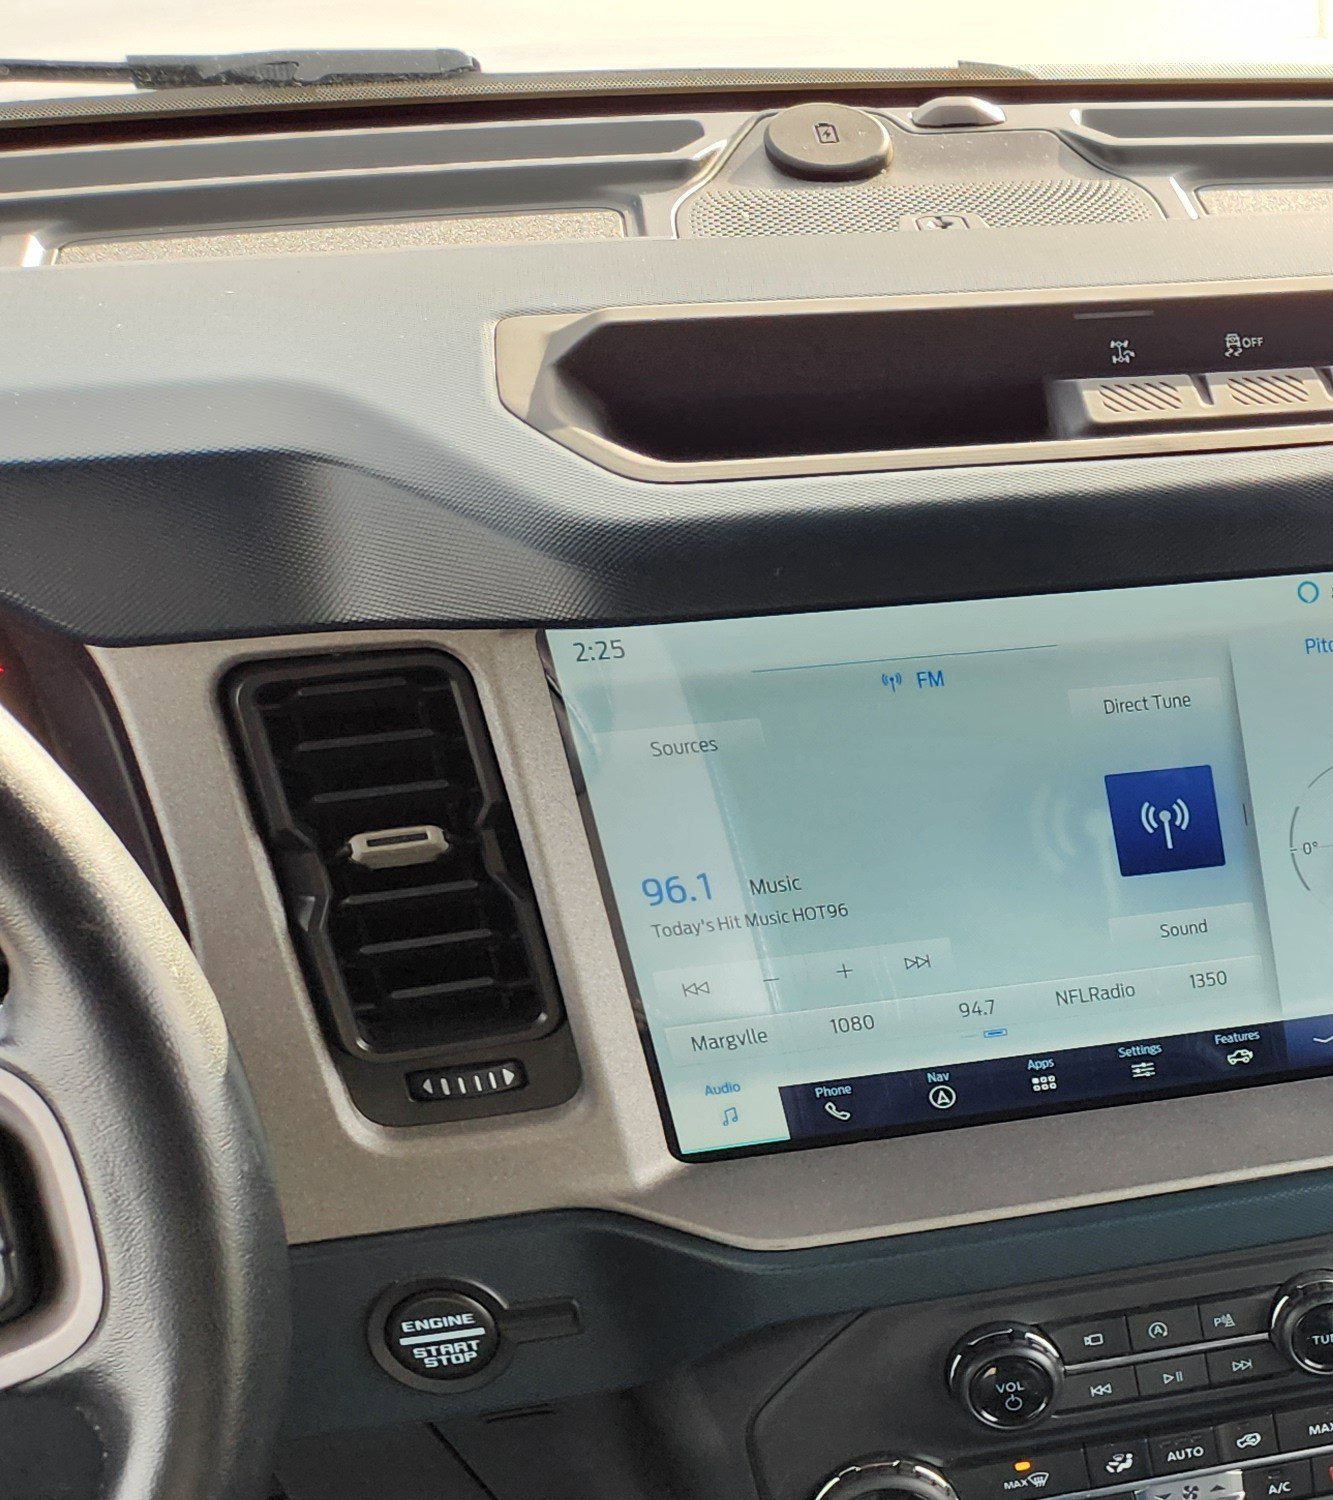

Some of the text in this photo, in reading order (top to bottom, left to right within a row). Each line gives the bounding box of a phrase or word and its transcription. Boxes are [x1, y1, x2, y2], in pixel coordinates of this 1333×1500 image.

[1242, 335, 1264, 349] OFF
[572, 639, 626, 663] 2:25
[916, 670, 945, 689] FM
[1103, 693, 1191, 715] Direct Tune
[650, 736, 719, 758] Sources
[641, 873, 713, 907] 96.1
[749, 875, 802, 896] Music
[651, 902, 850, 940] Today's Hit Music HOT96
[1160, 918, 1208, 939] Sound
[1189, 970, 1228, 989] 1350
[1055, 982, 1136, 1007] NFLRadio
[958, 1000, 996, 1018] 94.7
[829, 1014, 876, 1035] 1080
[690, 1027, 769, 1054] Margvlle
[1214, 1029, 1260, 1046] Features
[1118, 1042, 1163, 1059] Settings
[1027, 1056, 1055, 1072] Apps
[927, 1070, 950, 1084] Nav
[705, 1080, 741, 1097] Audio
[815, 1083, 853, 1099] Phone
[401, 1313, 476, 1334] ENGINE
[412, 1339, 480, 1360] START
[423, 1350, 478, 1369] STOP
[996, 1382, 1025, 1394] VOL
[1167, 1445, 1204, 1462] AUTO
[1004, 1477, 1029, 1490] MAX
[1268, 1480, 1291, 1496] A/C
